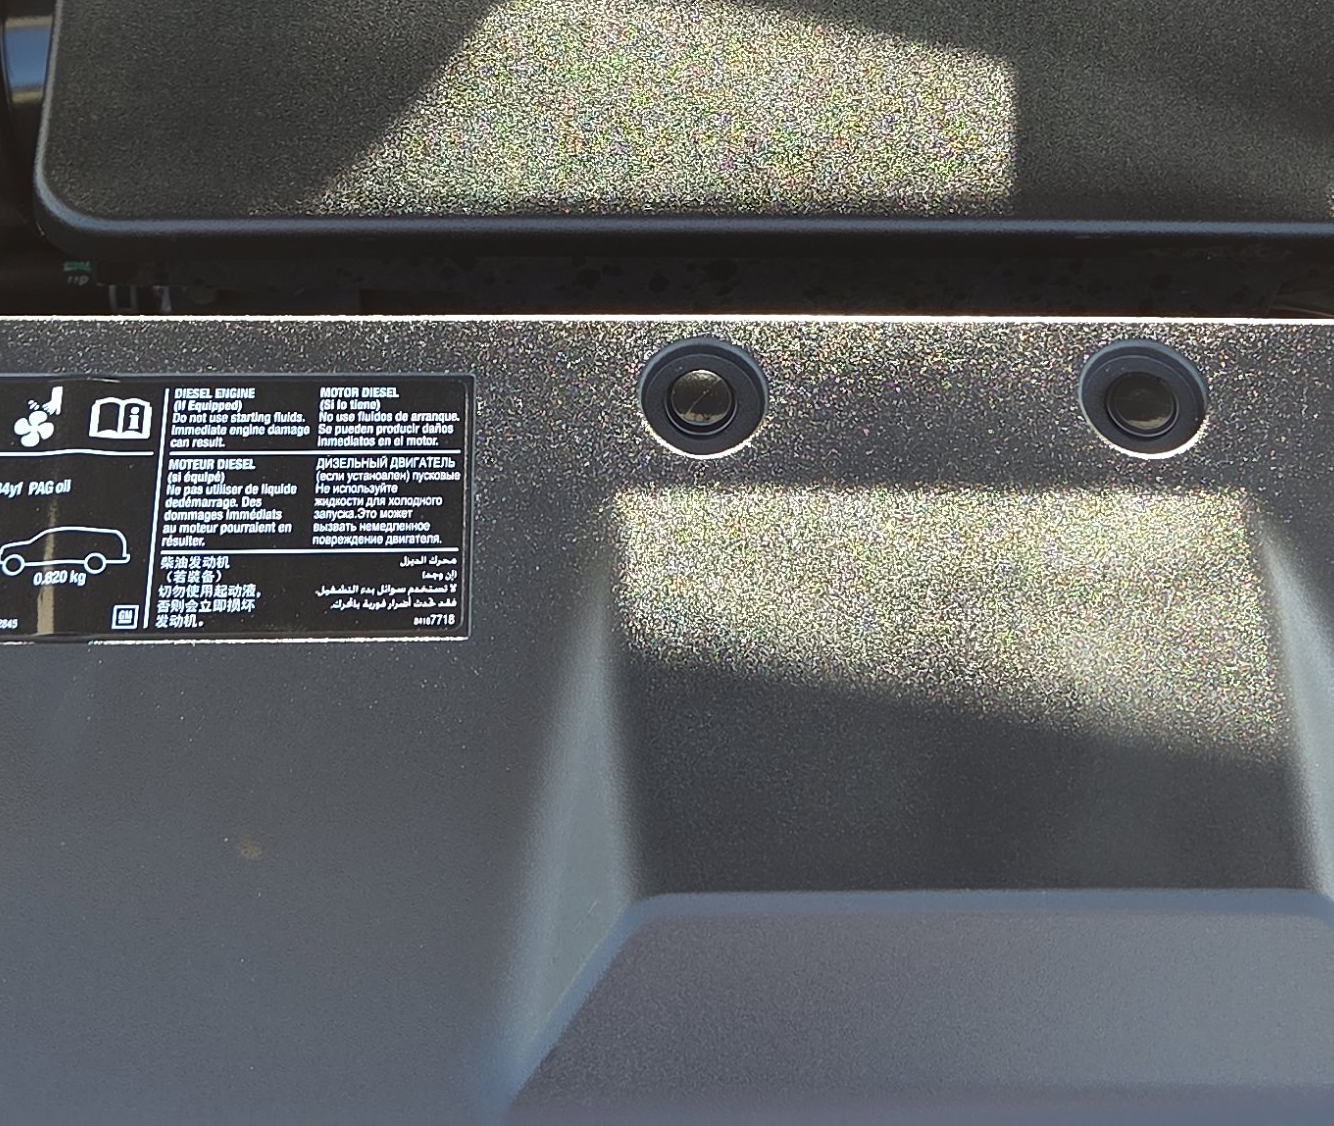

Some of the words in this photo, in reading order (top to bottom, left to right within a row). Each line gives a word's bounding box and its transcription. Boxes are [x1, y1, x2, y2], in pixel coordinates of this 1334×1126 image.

[175, 388, 213, 398] DIESEL
[215, 388, 255, 398] ENGINE
[320, 387, 359, 398] MOTOR
[362, 387, 399, 398] DIESEL
[174, 400, 186, 412] (If
[188, 400, 242, 413] Equipped)
[320, 399, 334, 411] (Si
[337, 399, 347, 410] lo
[350, 399, 380, 412] tiene)
[172, 413, 187, 423] Do
[189, 412, 207, 423] not
[209, 414, 227, 423] use
[231, 412, 271, 425] starting
[274, 412, 305, 422] fluids.
[319, 411, 333, 422] No
[336, 413, 355, 422] use
[358, 411, 392, 422] fluidos
[395, 411, 408, 422] de
[411, 413, 460, 423] arranque.
[171, 425, 227, 435] Immediate
[229, 424, 265, 437] engine
[267, 424, 310, 437] damage
[318, 424, 332, 434] Se
[335, 424, 373, 436] pueden
[376, 424, 420, 436] producir
[422, 423, 454, 434] daños
[170, 439, 189, 447] can
[192, 436, 225, 447] result.
[378, 437, 391, 446] en
[394, 435, 403, 446] el
[407, 436, 438, 446] motor.
[168, 459, 215, 470] MOTEUR
[217, 458, 256, 470] DIESEL
[316, 456, 388, 470] ДИЗЕЛЬНЫЙ
[390, 457, 455, 471] ДВИГАТЕЛЬ
[167, 472, 181, 484] (si
[184, 471, 225, 484] équipé)
[316, 471, 344, 483] (если
[347, 470, 410, 483] установлен)
[413, 472, 461, 483] пусковые
[28, 482, 54, 495] PAG
[55, 479, 71, 493] oil
[166, 484, 181, 495] Ne
[183, 486, 203, 498] pas
[206, 483, 243, 495] utiliser
[245, 484, 259, 494] de
[261, 483, 297, 496] liquide
[315, 482, 330, 493] Не
[333, 482, 398, 495] используйте
[241, 496, 262, 507] Des
[314, 497, 364, 507] жидкости
[365, 497, 386, 507] для
[388, 497, 442, 507] холодного
[164, 510, 223, 522] dommages
[225, 508, 282, 520] immédiats
[380, 510, 413, 518] может
[163, 525, 176, 534] au
[179, 522, 218, 533] moteur
[220, 522, 276, 535] pourraient
[278, 524, 292, 533] en
[313, 523, 357, 532] вызвать
[359, 522, 430, 532] немедленное
[162, 535, 205, 546] résulter.
[313, 536, 383, 547] повреждение
[385, 534, 442, 545] двигателя.
[161, 556, 230, 569] 柴油发动机
[69, 569, 87, 586] kg
[157, 598, 255, 613] 否则会立即损坏
